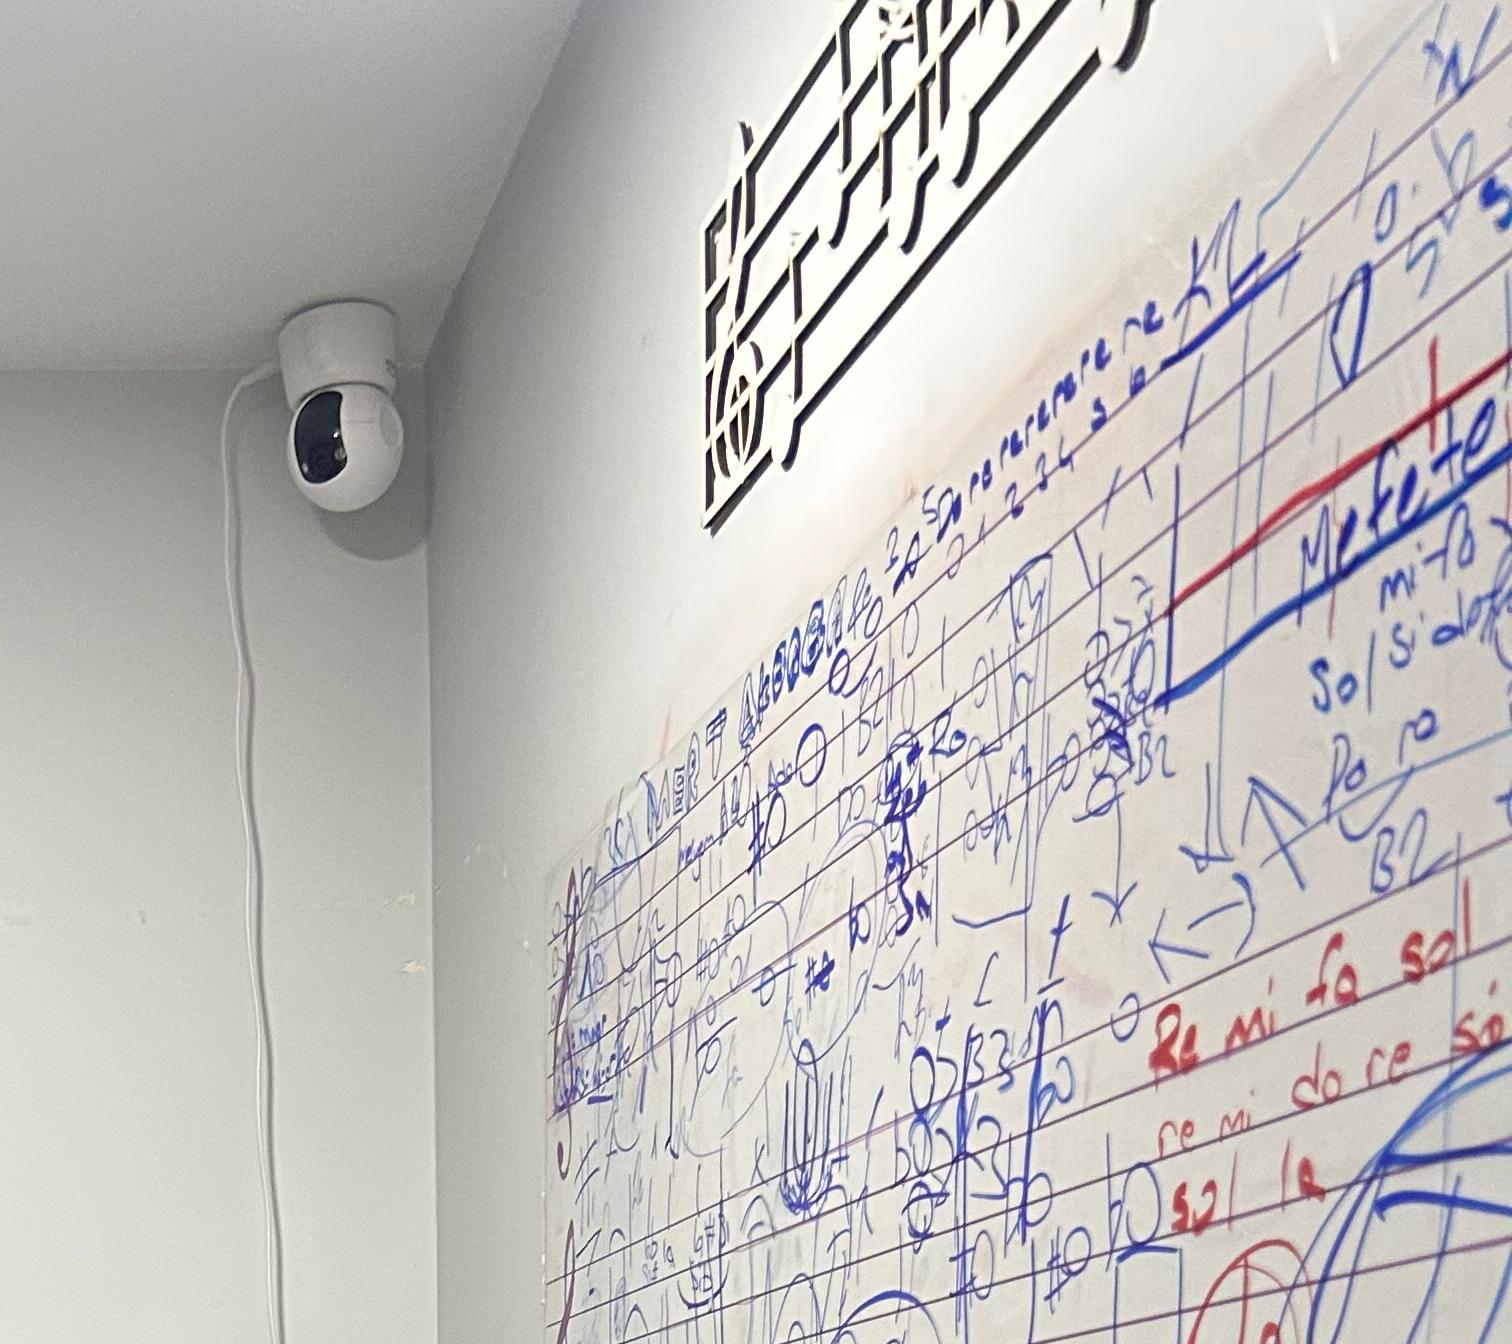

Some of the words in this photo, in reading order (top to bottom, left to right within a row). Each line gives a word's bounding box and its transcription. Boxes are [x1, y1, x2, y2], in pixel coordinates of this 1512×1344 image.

[1157, 1119, 1195, 1158] re
[1291, 1040, 1342, 1111] do
[1366, 1041, 1412, 1086] re
